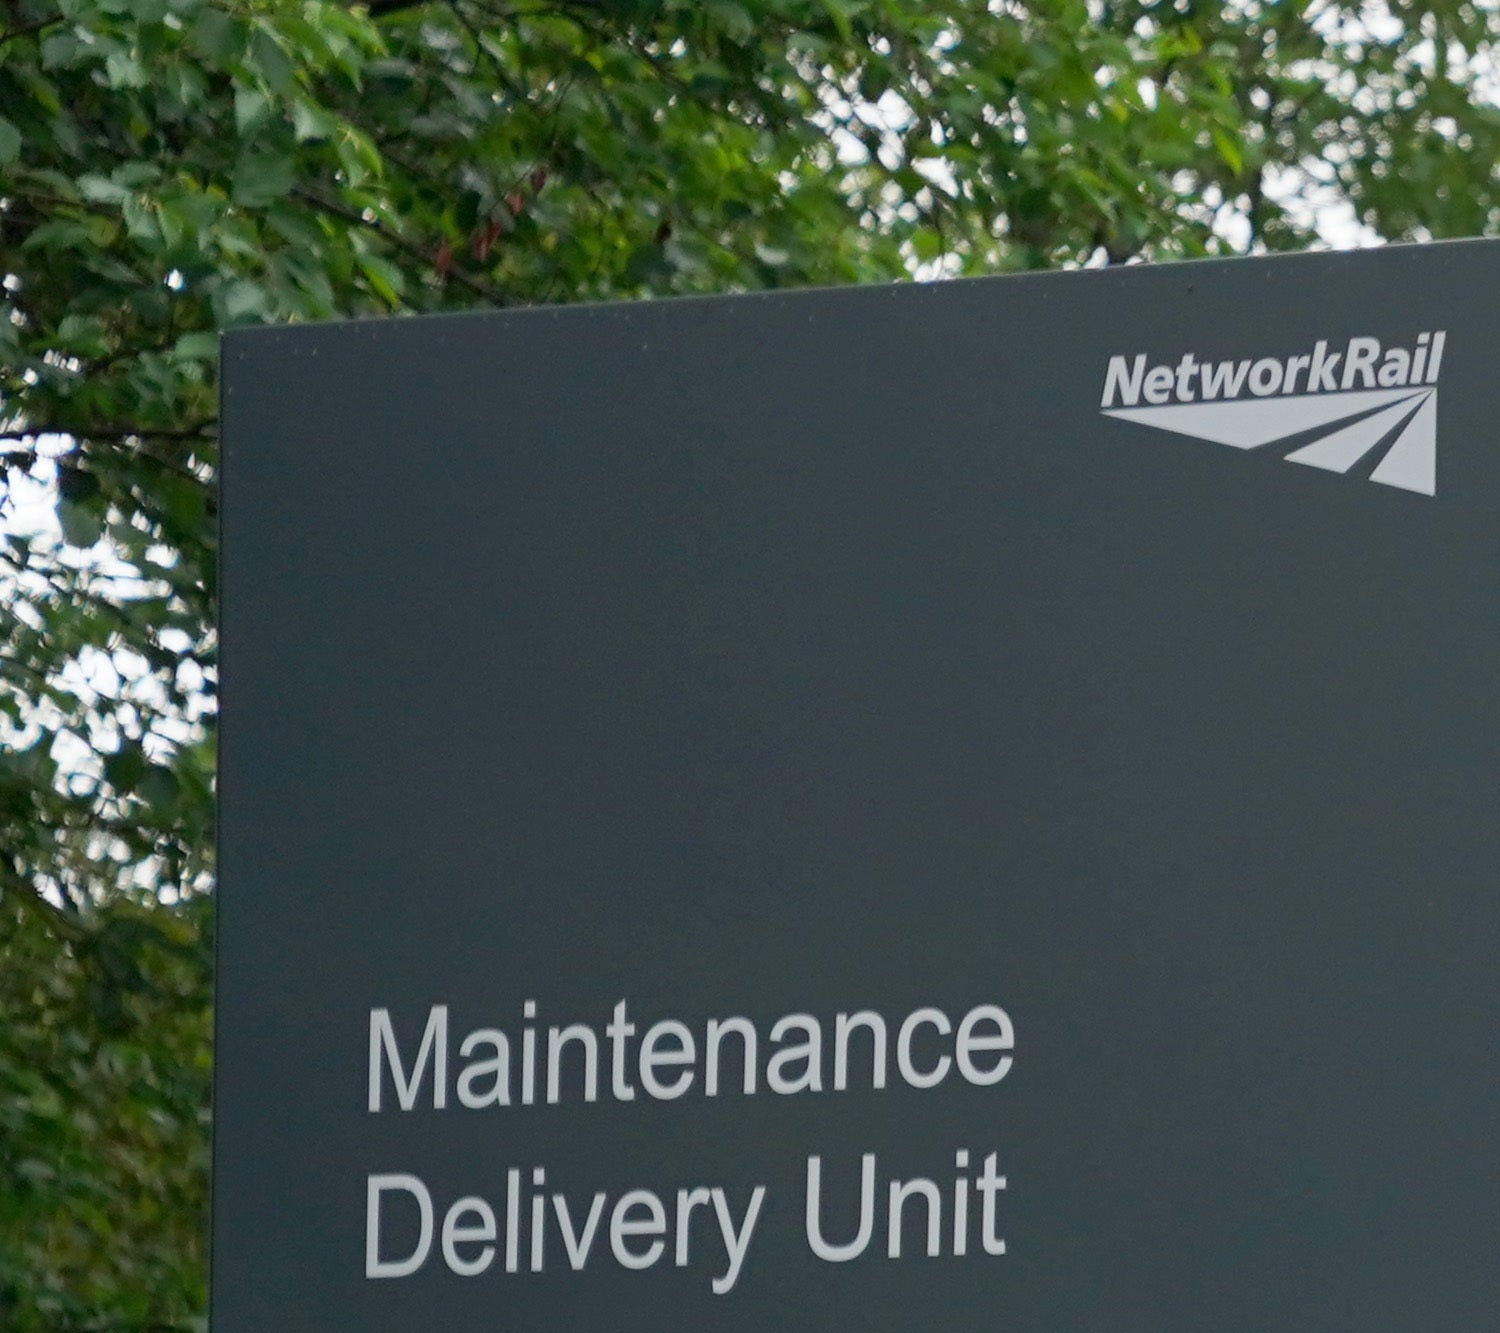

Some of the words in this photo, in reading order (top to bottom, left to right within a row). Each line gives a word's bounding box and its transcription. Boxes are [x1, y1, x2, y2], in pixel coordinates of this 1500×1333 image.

[1101, 330, 1447, 407] NetworkRail
[368, 1000, 1015, 1112] Maintenance
[366, 1168, 767, 1294] Delivery
[806, 1151, 1007, 1262] Unit
